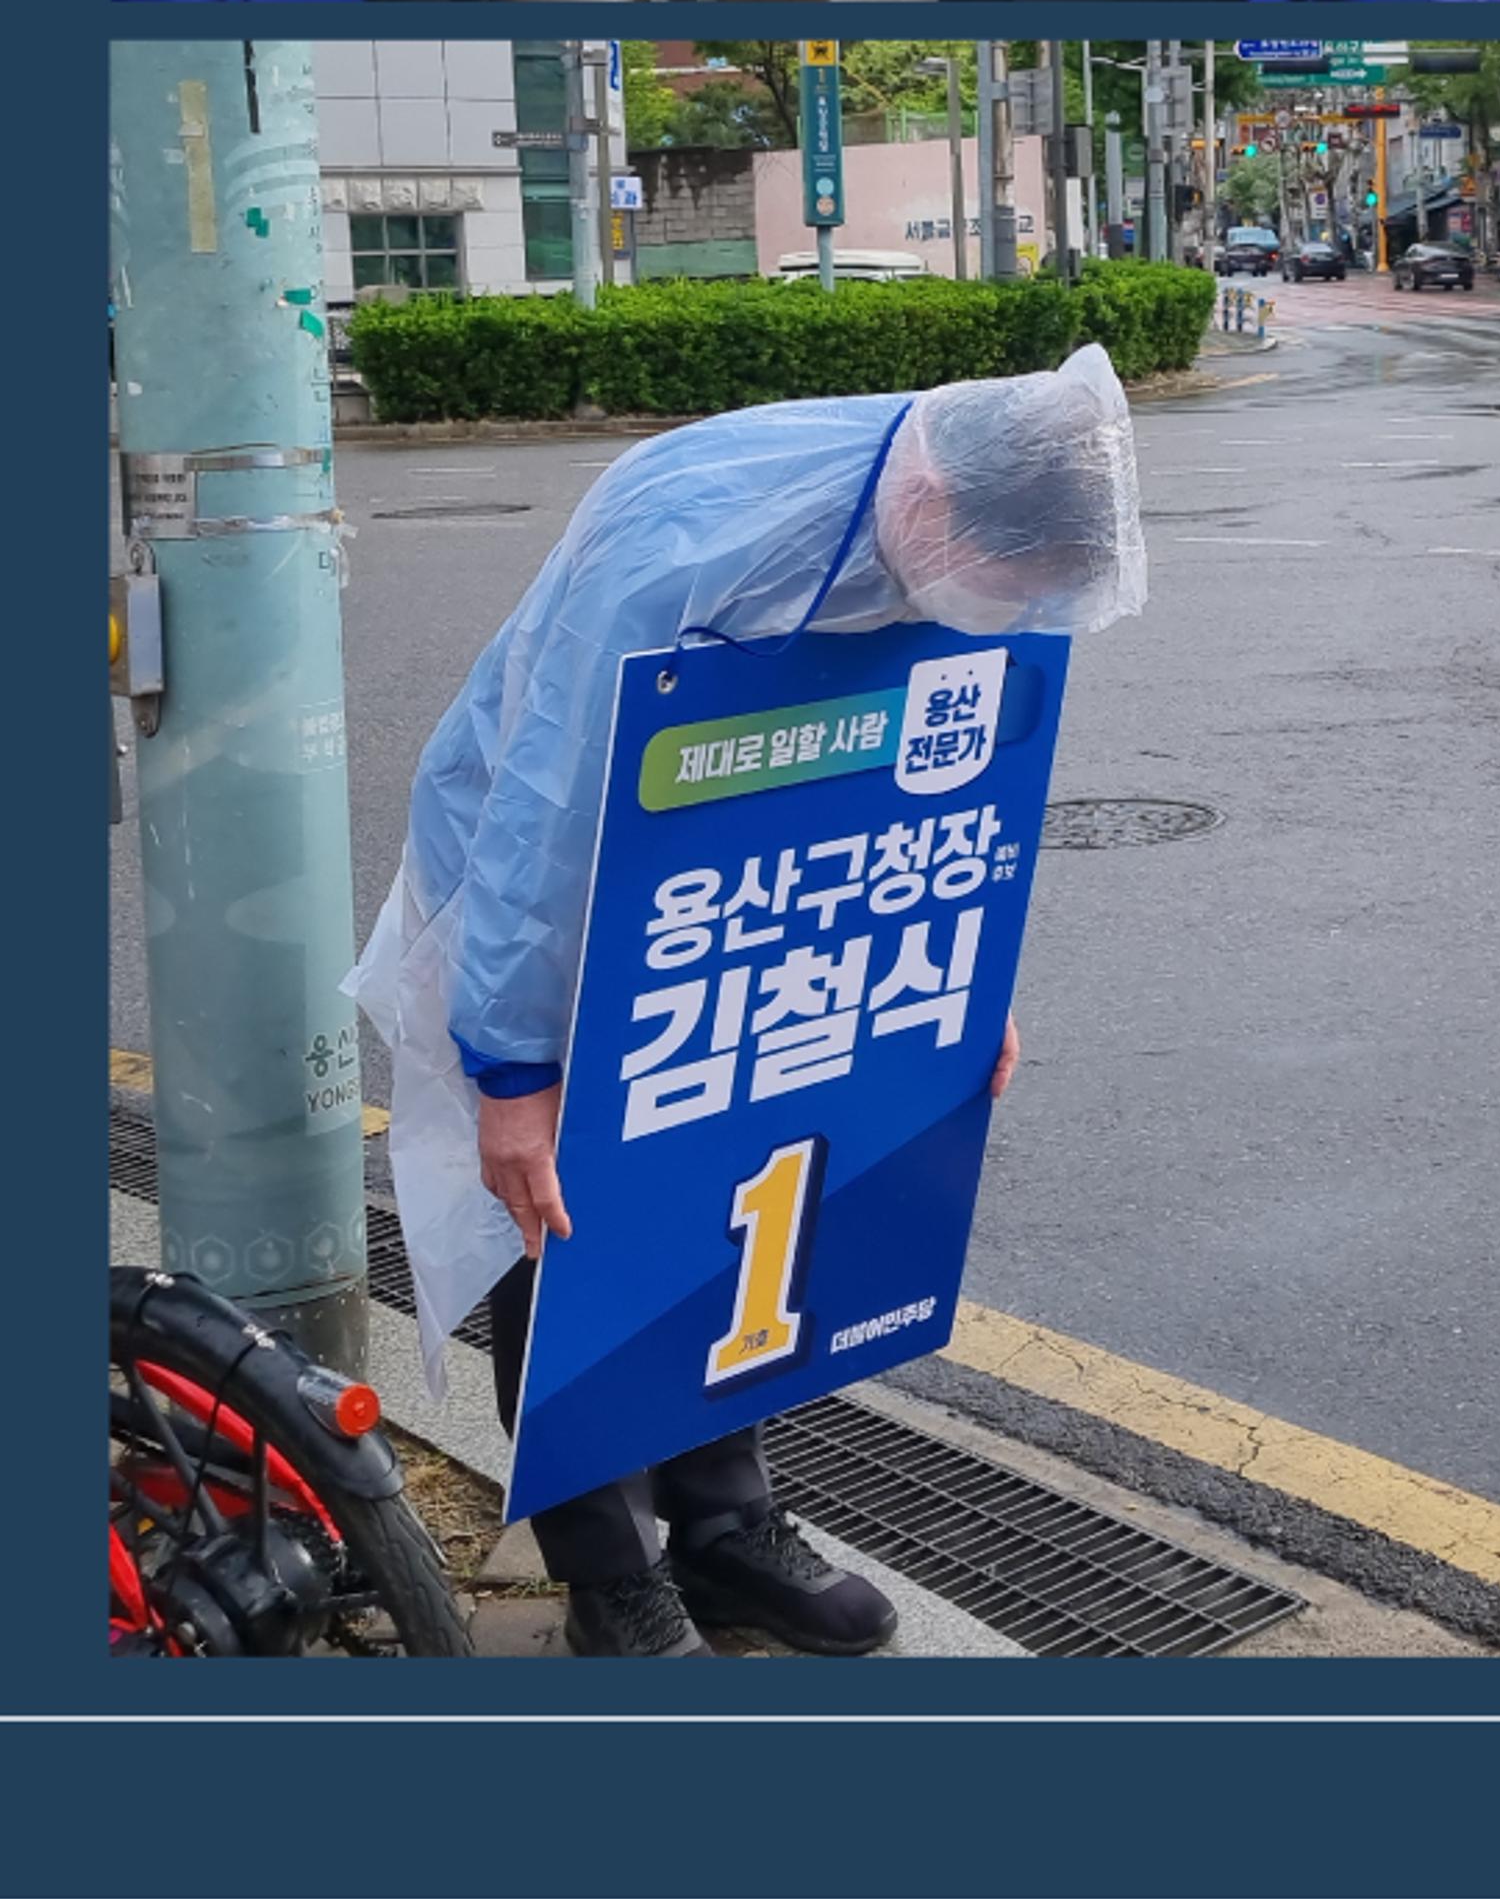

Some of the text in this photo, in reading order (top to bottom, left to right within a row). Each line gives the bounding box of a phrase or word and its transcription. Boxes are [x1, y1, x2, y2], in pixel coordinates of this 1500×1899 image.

[925, 683, 982, 728] 용산
[675, 710, 890, 783] 제대로 일할 사람
[905, 724, 987, 775] 전문가
[645, 804, 1001, 970] 용산구청장
[619, 906, 984, 1142] 김철식
[704, 1138, 815, 1386] 1
[829, 1296, 937, 1354] 더불어민주당
